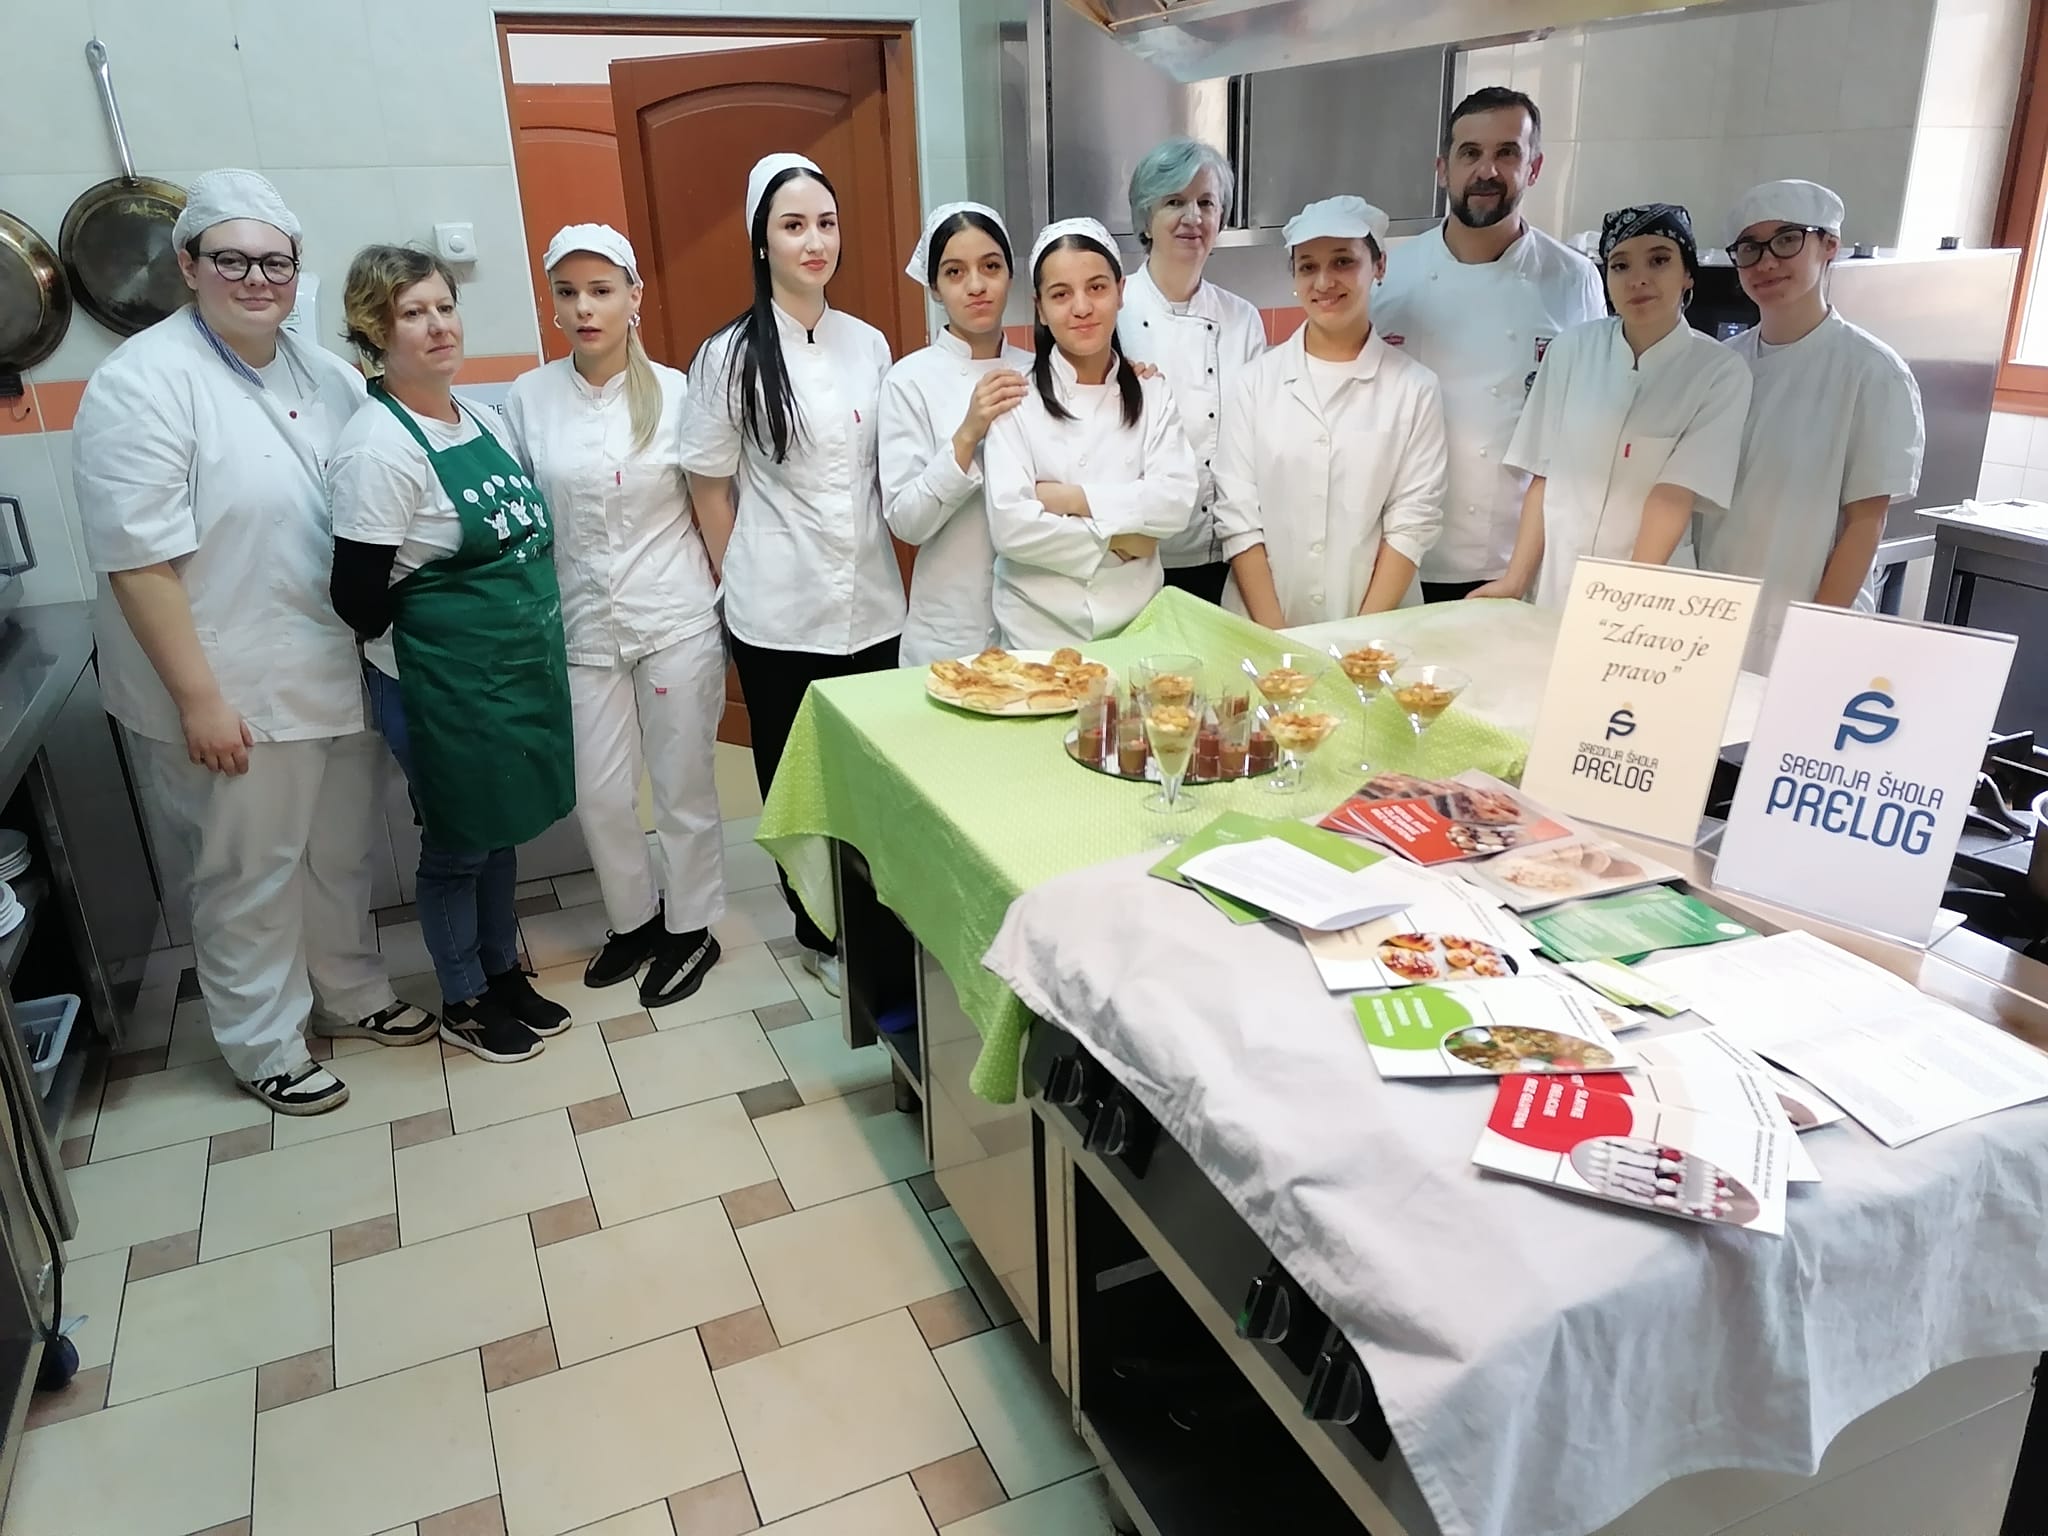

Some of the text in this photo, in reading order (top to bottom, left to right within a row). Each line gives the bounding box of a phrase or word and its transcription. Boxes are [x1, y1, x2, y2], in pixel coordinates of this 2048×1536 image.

[1585, 581, 1741, 621] Program SHE
[1681, 635, 1710, 661] je
[1572, 754, 1655, 793] PRELOG
[1578, 741, 1659, 769] SREDNJA ŠKOLA
[1780, 753, 1944, 810] SREDNJA ŠKOLA
[1766, 776, 1936, 855] PRELOG
